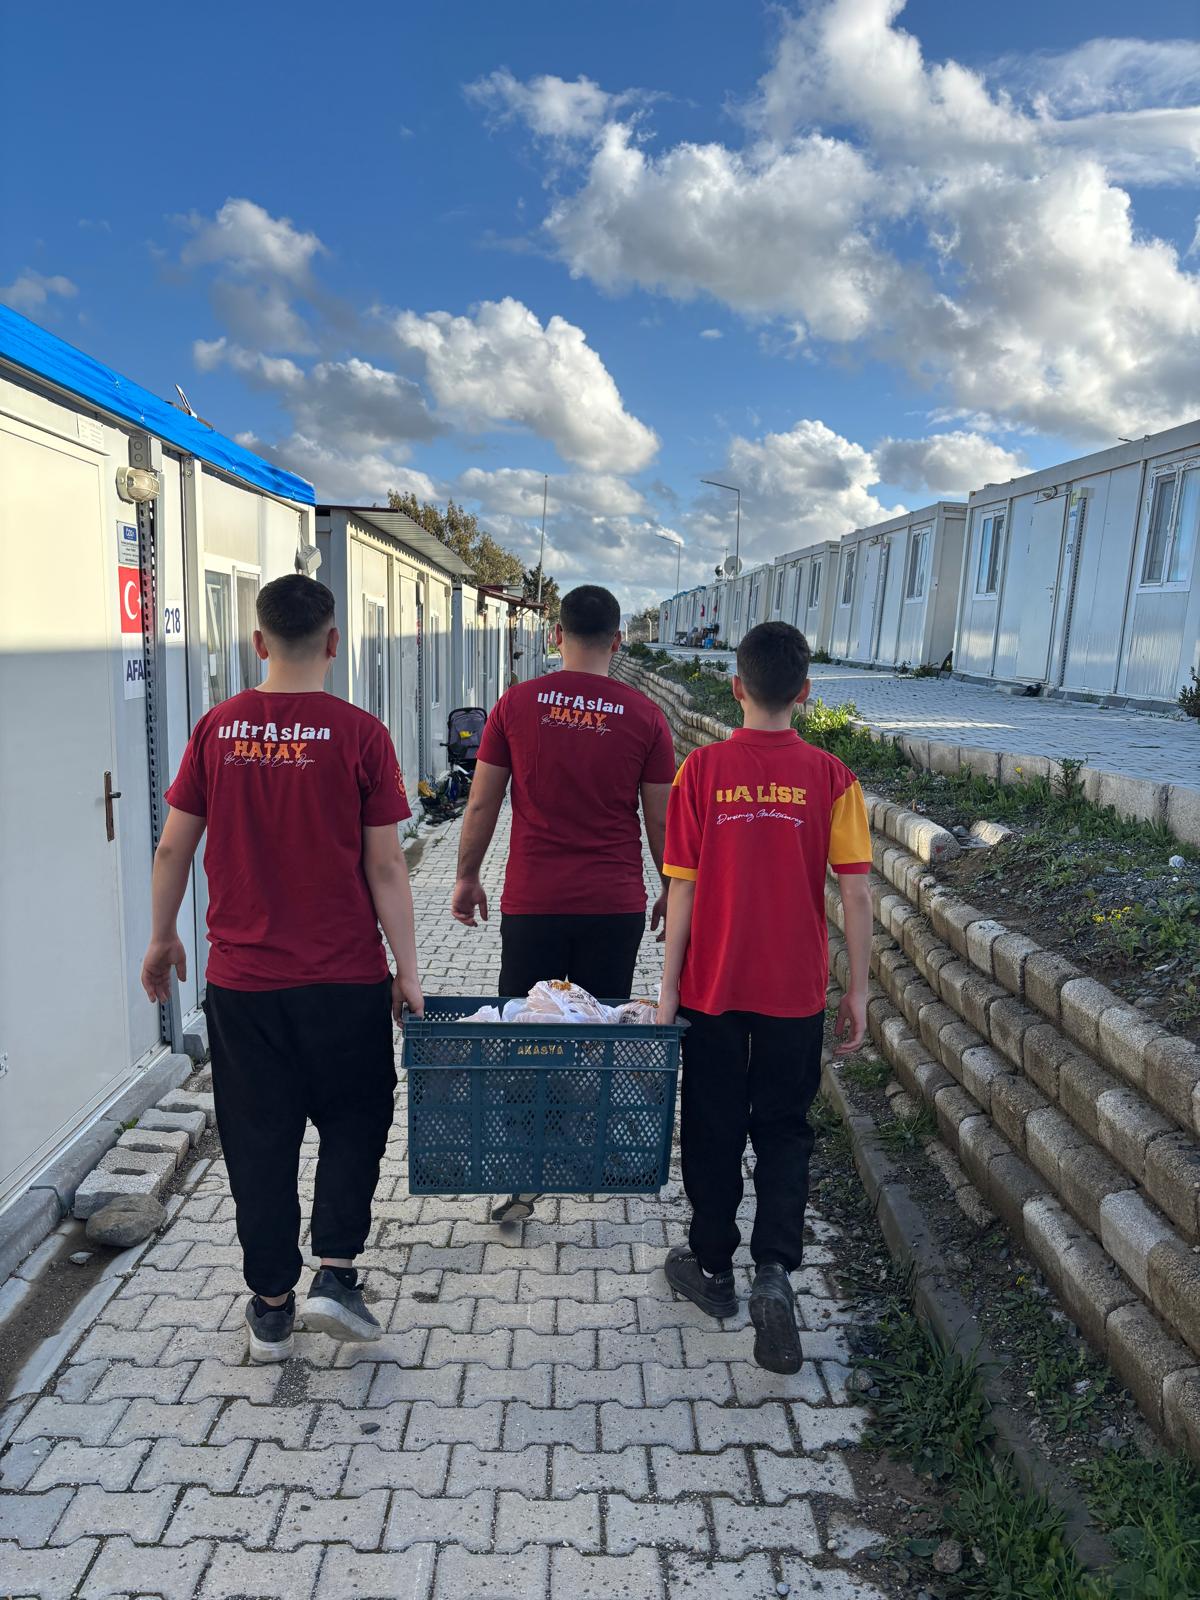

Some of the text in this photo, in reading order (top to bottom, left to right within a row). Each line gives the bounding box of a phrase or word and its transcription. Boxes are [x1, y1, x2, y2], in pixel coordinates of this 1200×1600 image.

[164, 608, 181, 633] 218
[126, 659, 146, 681] AFA
[537, 690, 625, 715] ultrAslan
[549, 706, 607, 726] HATAY
[218, 720, 331, 742] ultrAslan
[234, 740, 308, 759] HATAY
[757, 782, 807, 805] LİSE
